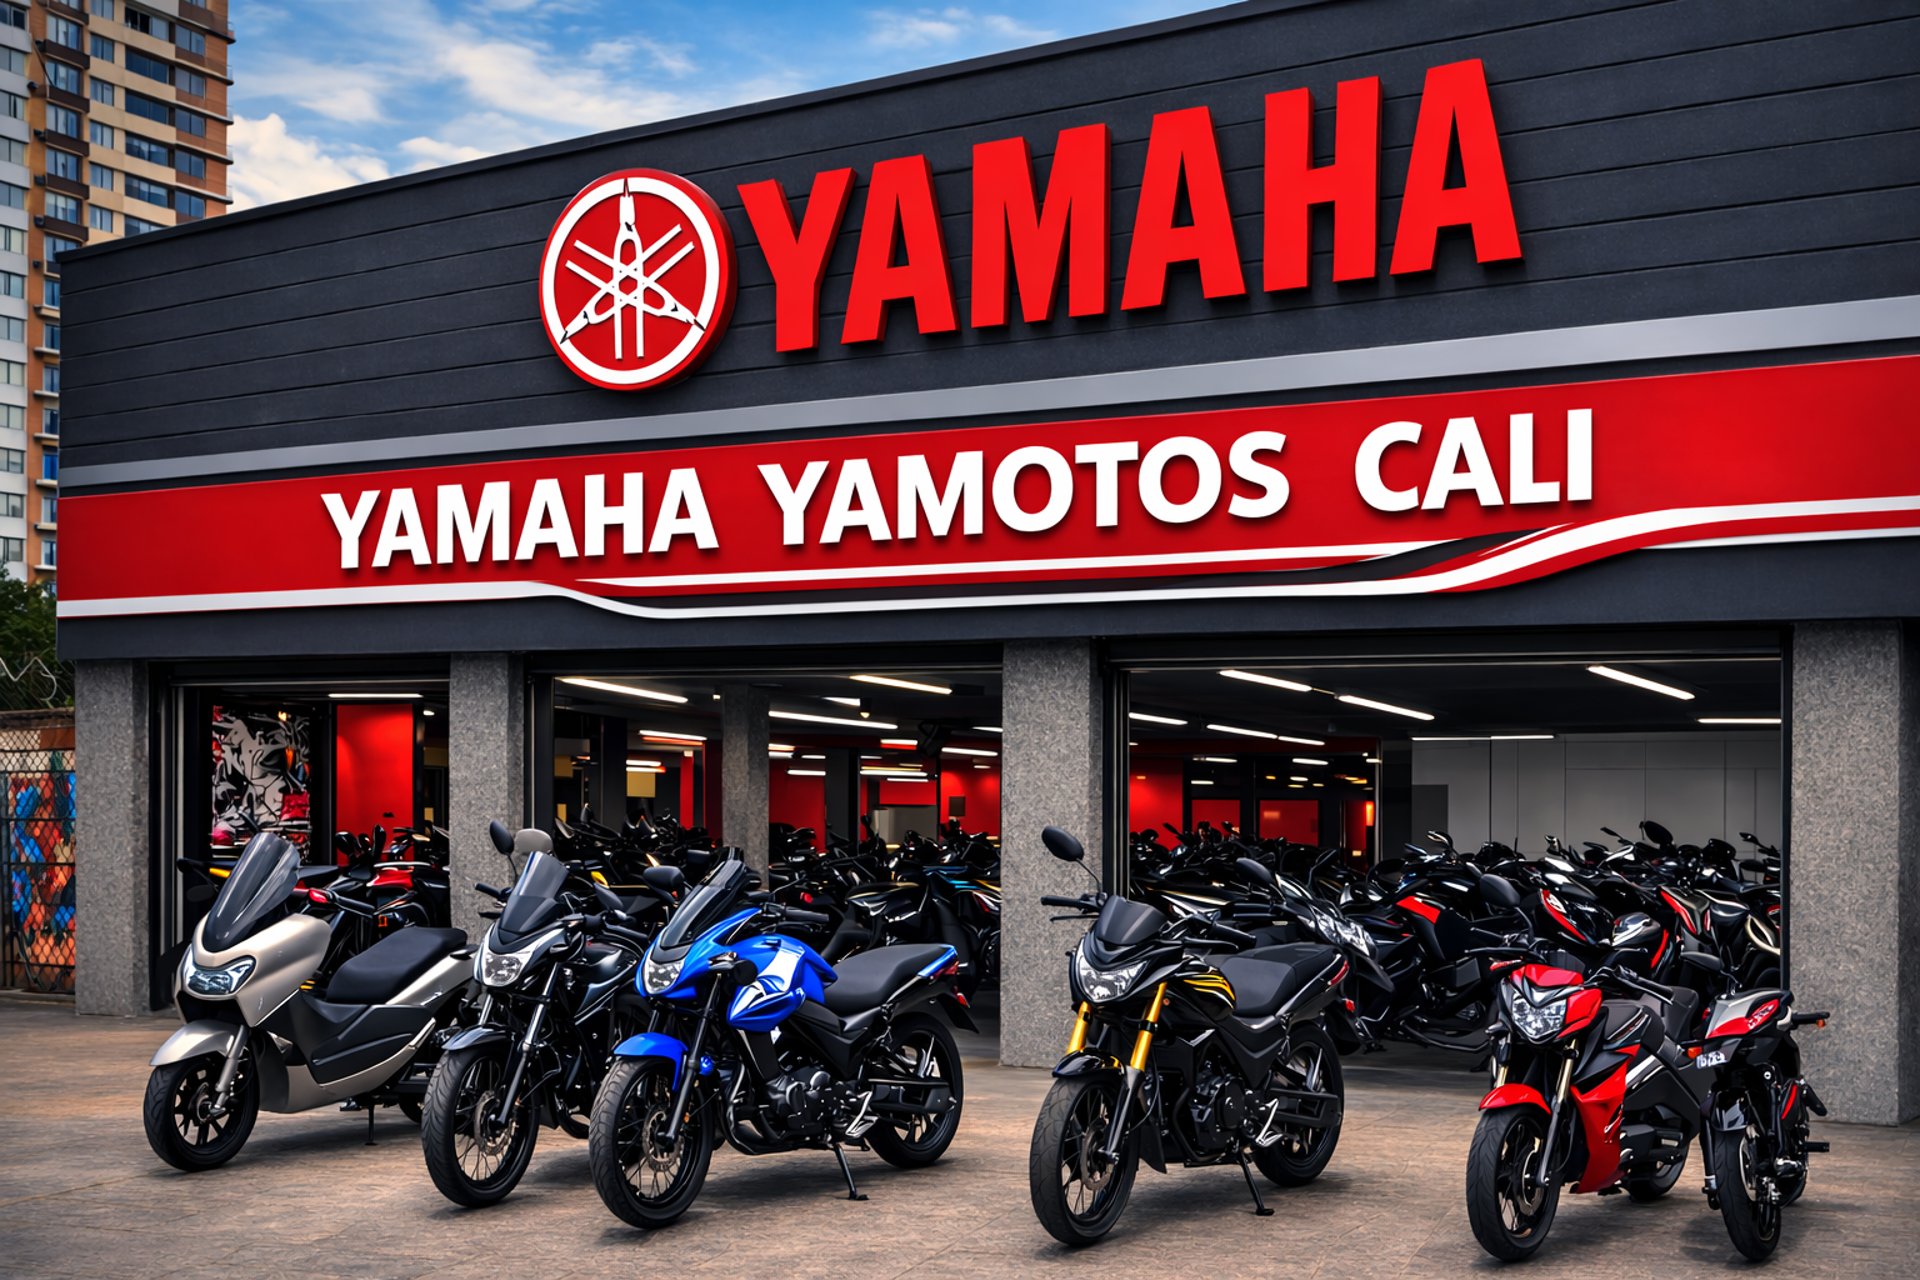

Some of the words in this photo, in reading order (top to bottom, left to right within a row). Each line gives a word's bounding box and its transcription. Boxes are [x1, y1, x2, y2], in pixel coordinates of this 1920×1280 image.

[738, 58, 1523, 352] YAMAHA
[320, 467, 719, 569] YAMAHA
[757, 430, 1290, 546] YAMOTOS
[1355, 408, 1592, 512] CALI
